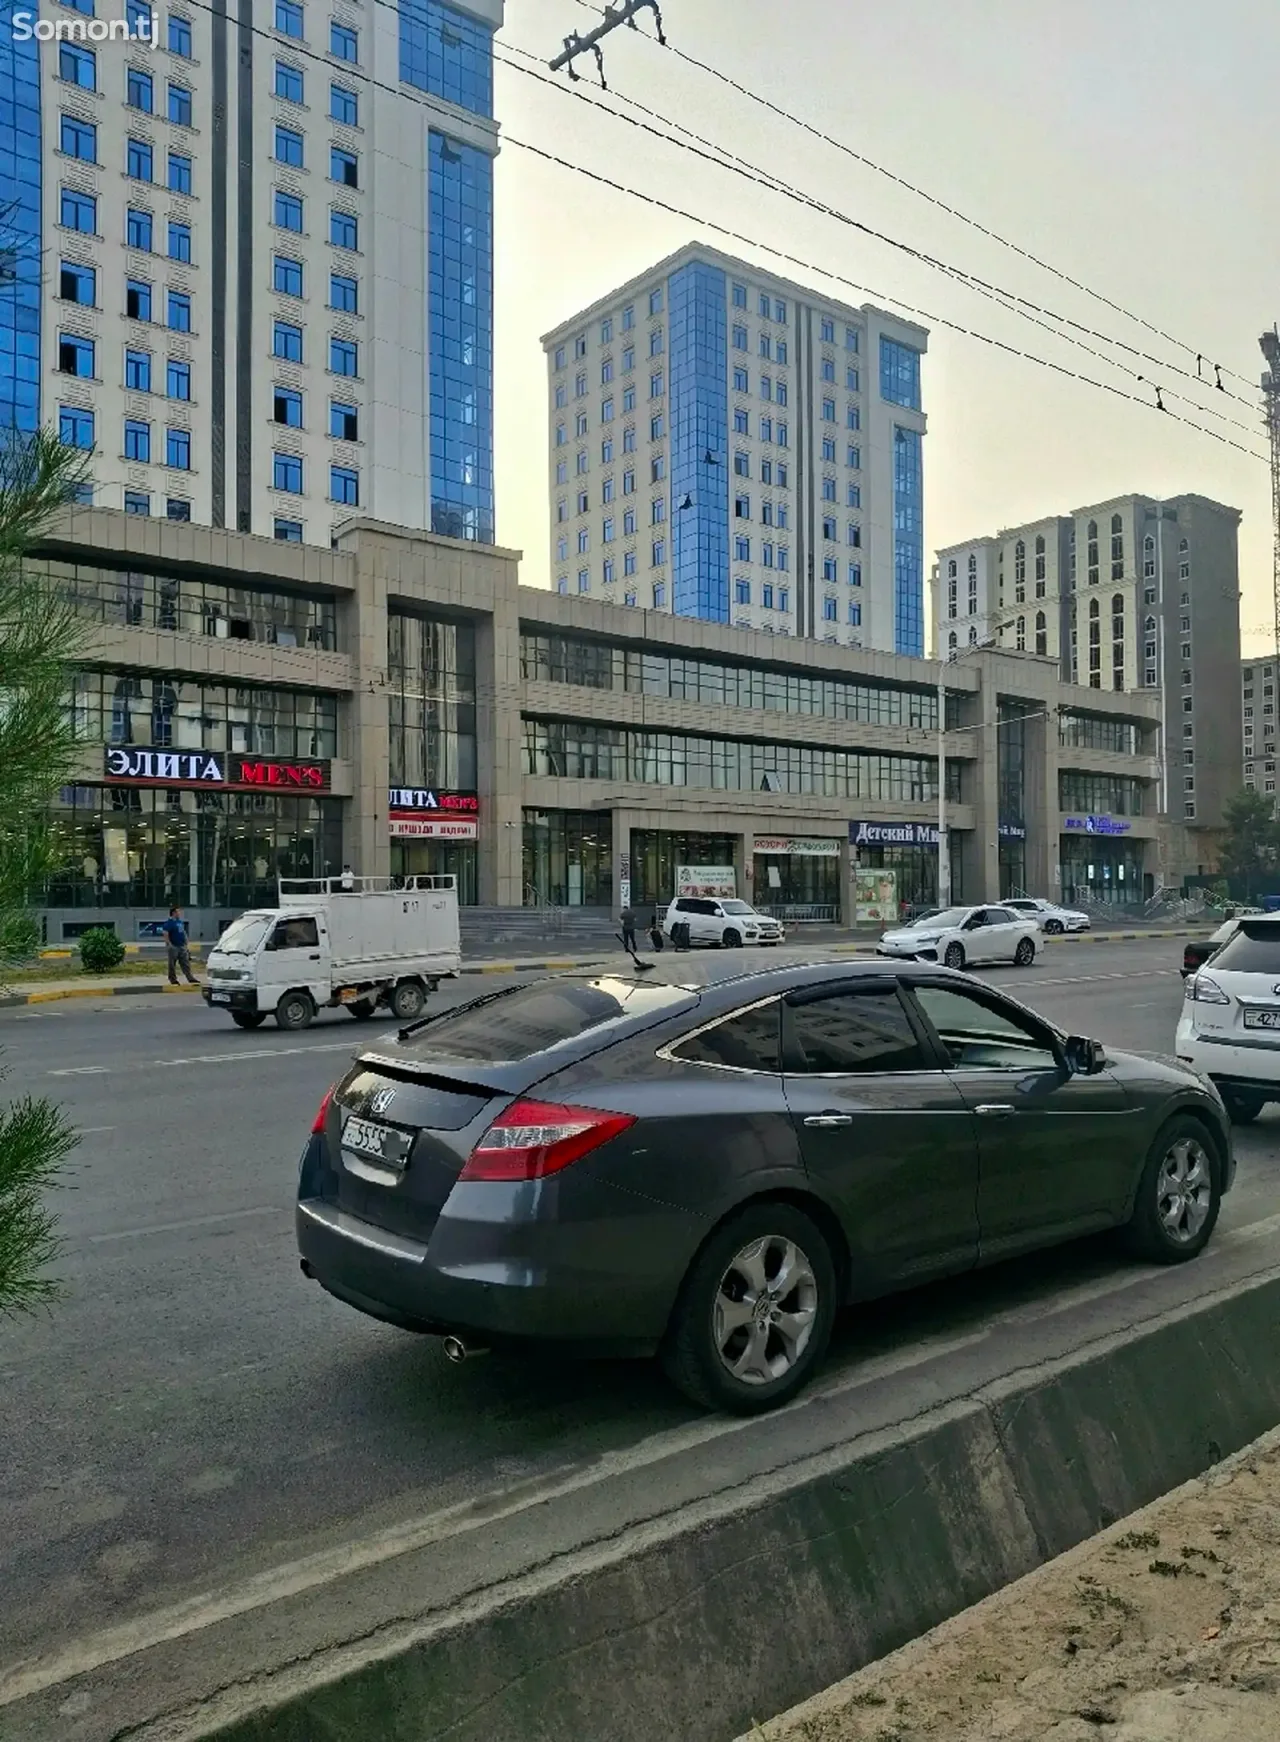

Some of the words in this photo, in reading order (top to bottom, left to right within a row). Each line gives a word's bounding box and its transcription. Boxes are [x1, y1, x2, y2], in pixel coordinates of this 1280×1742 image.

[107, 749, 224, 781] ЭЛИТА
[388, 789, 438, 808] ЛИТА
[855, 822, 914, 844] Детский
[916, 825, 941, 842] Ми
